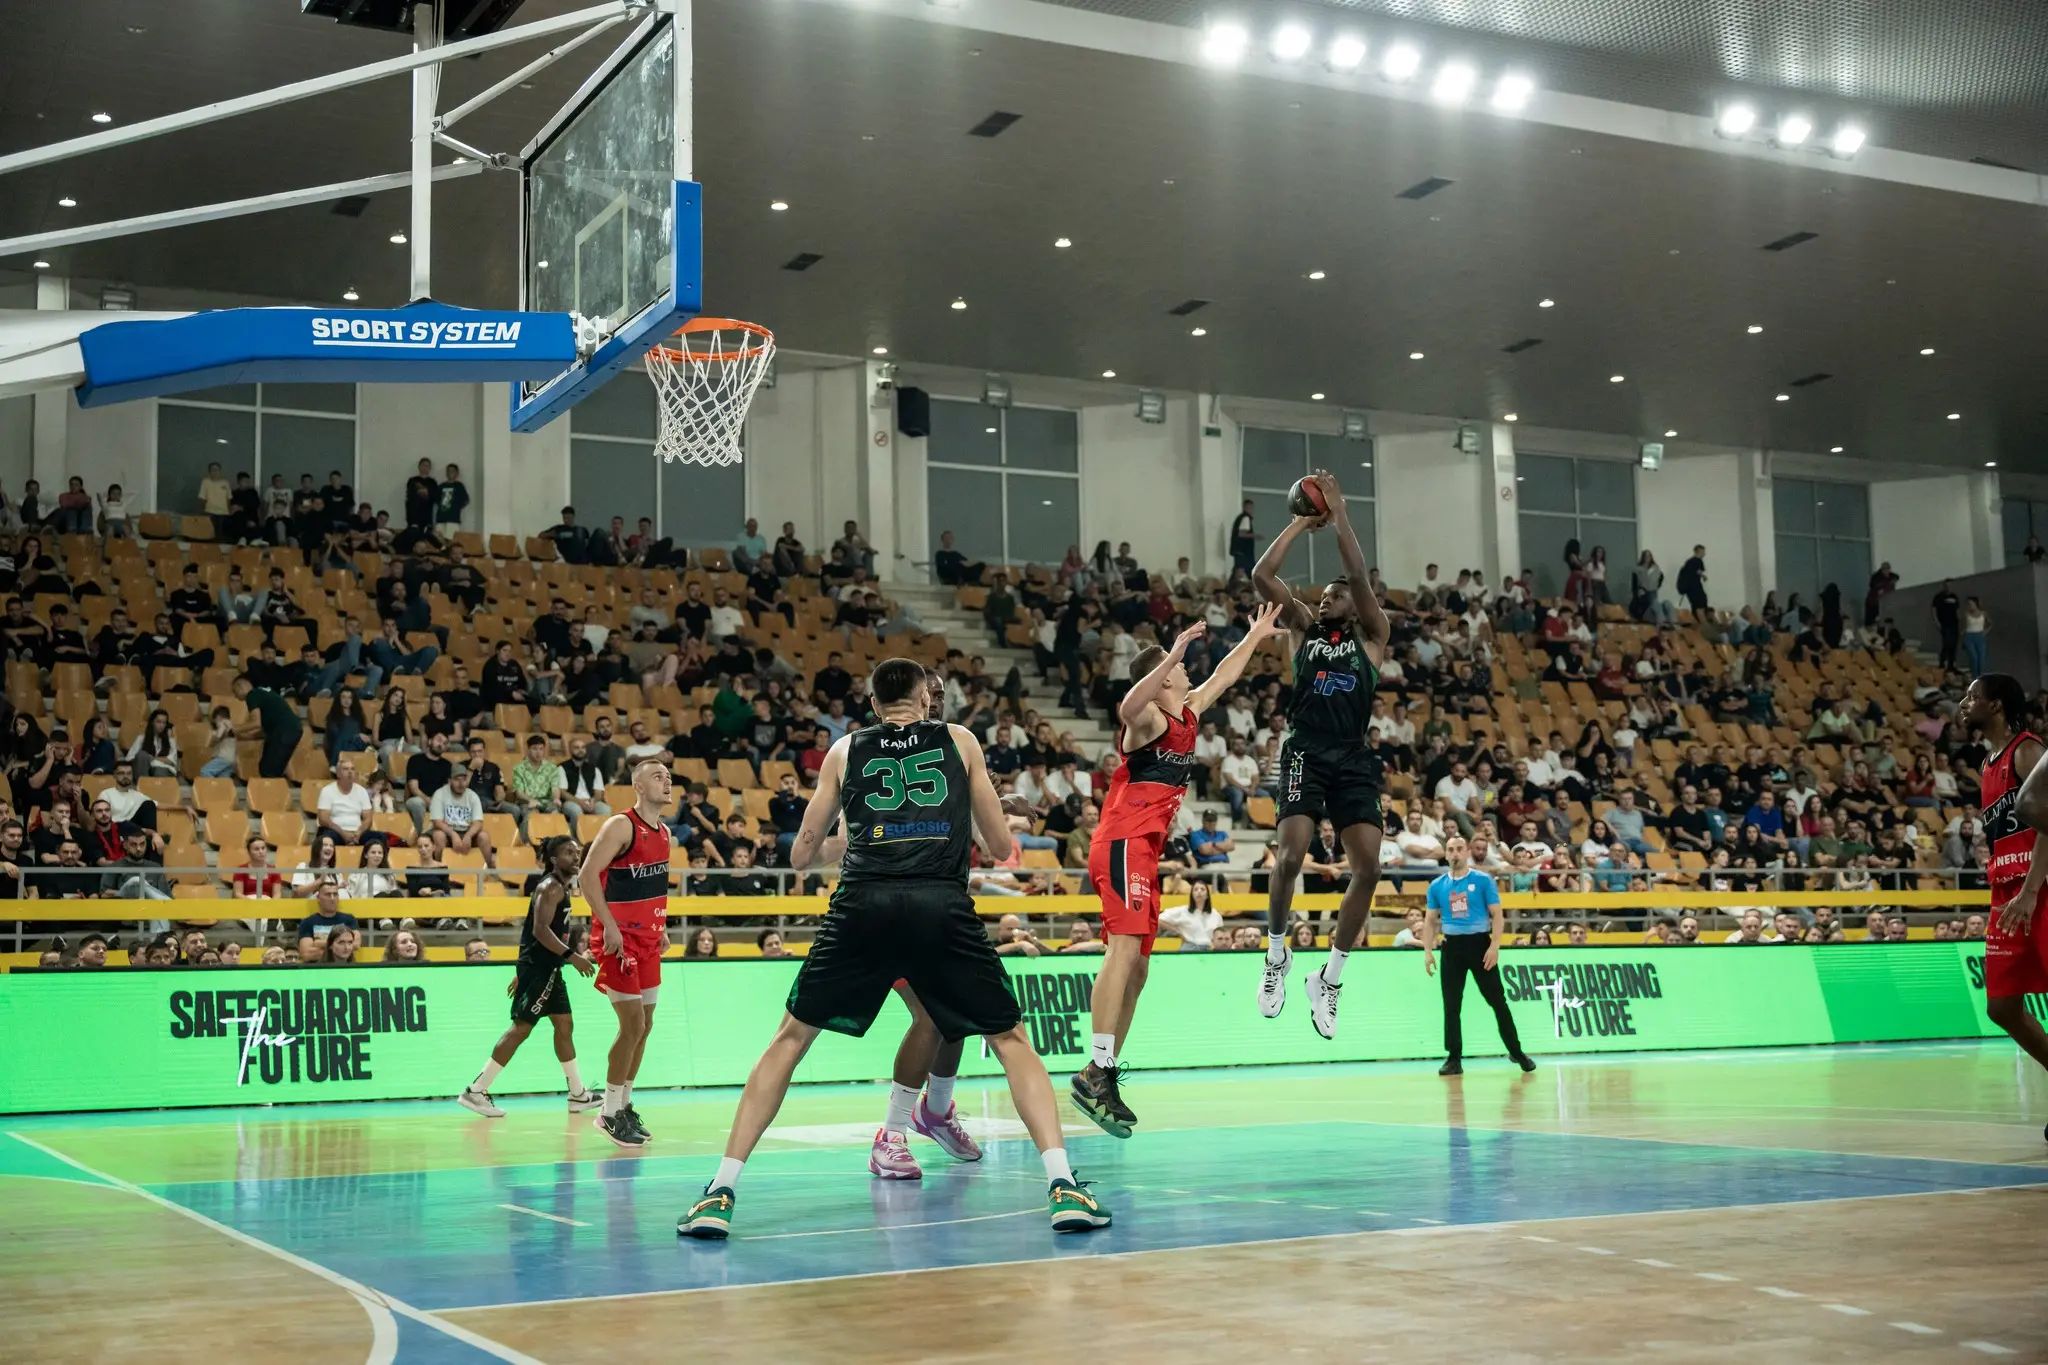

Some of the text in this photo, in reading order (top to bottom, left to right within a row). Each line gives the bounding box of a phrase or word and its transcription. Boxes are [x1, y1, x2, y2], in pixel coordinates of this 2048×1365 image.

[311, 317, 521, 348] SPORT SYSTEM
[1350, 656, 1360, 670] 2
[862, 748, 948, 811] 35
[885, 821, 950, 838] EUROSIG
[2006, 810, 2019, 833] 5
[1503, 963, 1662, 1001] SAFEGUARDING
[170, 986, 428, 1039] SAFEGUARDING
[1535, 977, 1585, 1040] The
[1551, 1000, 1637, 1038] FUTURE
[219, 1006, 296, 1088] The
[238, 1034, 373, 1085] FUTURE
